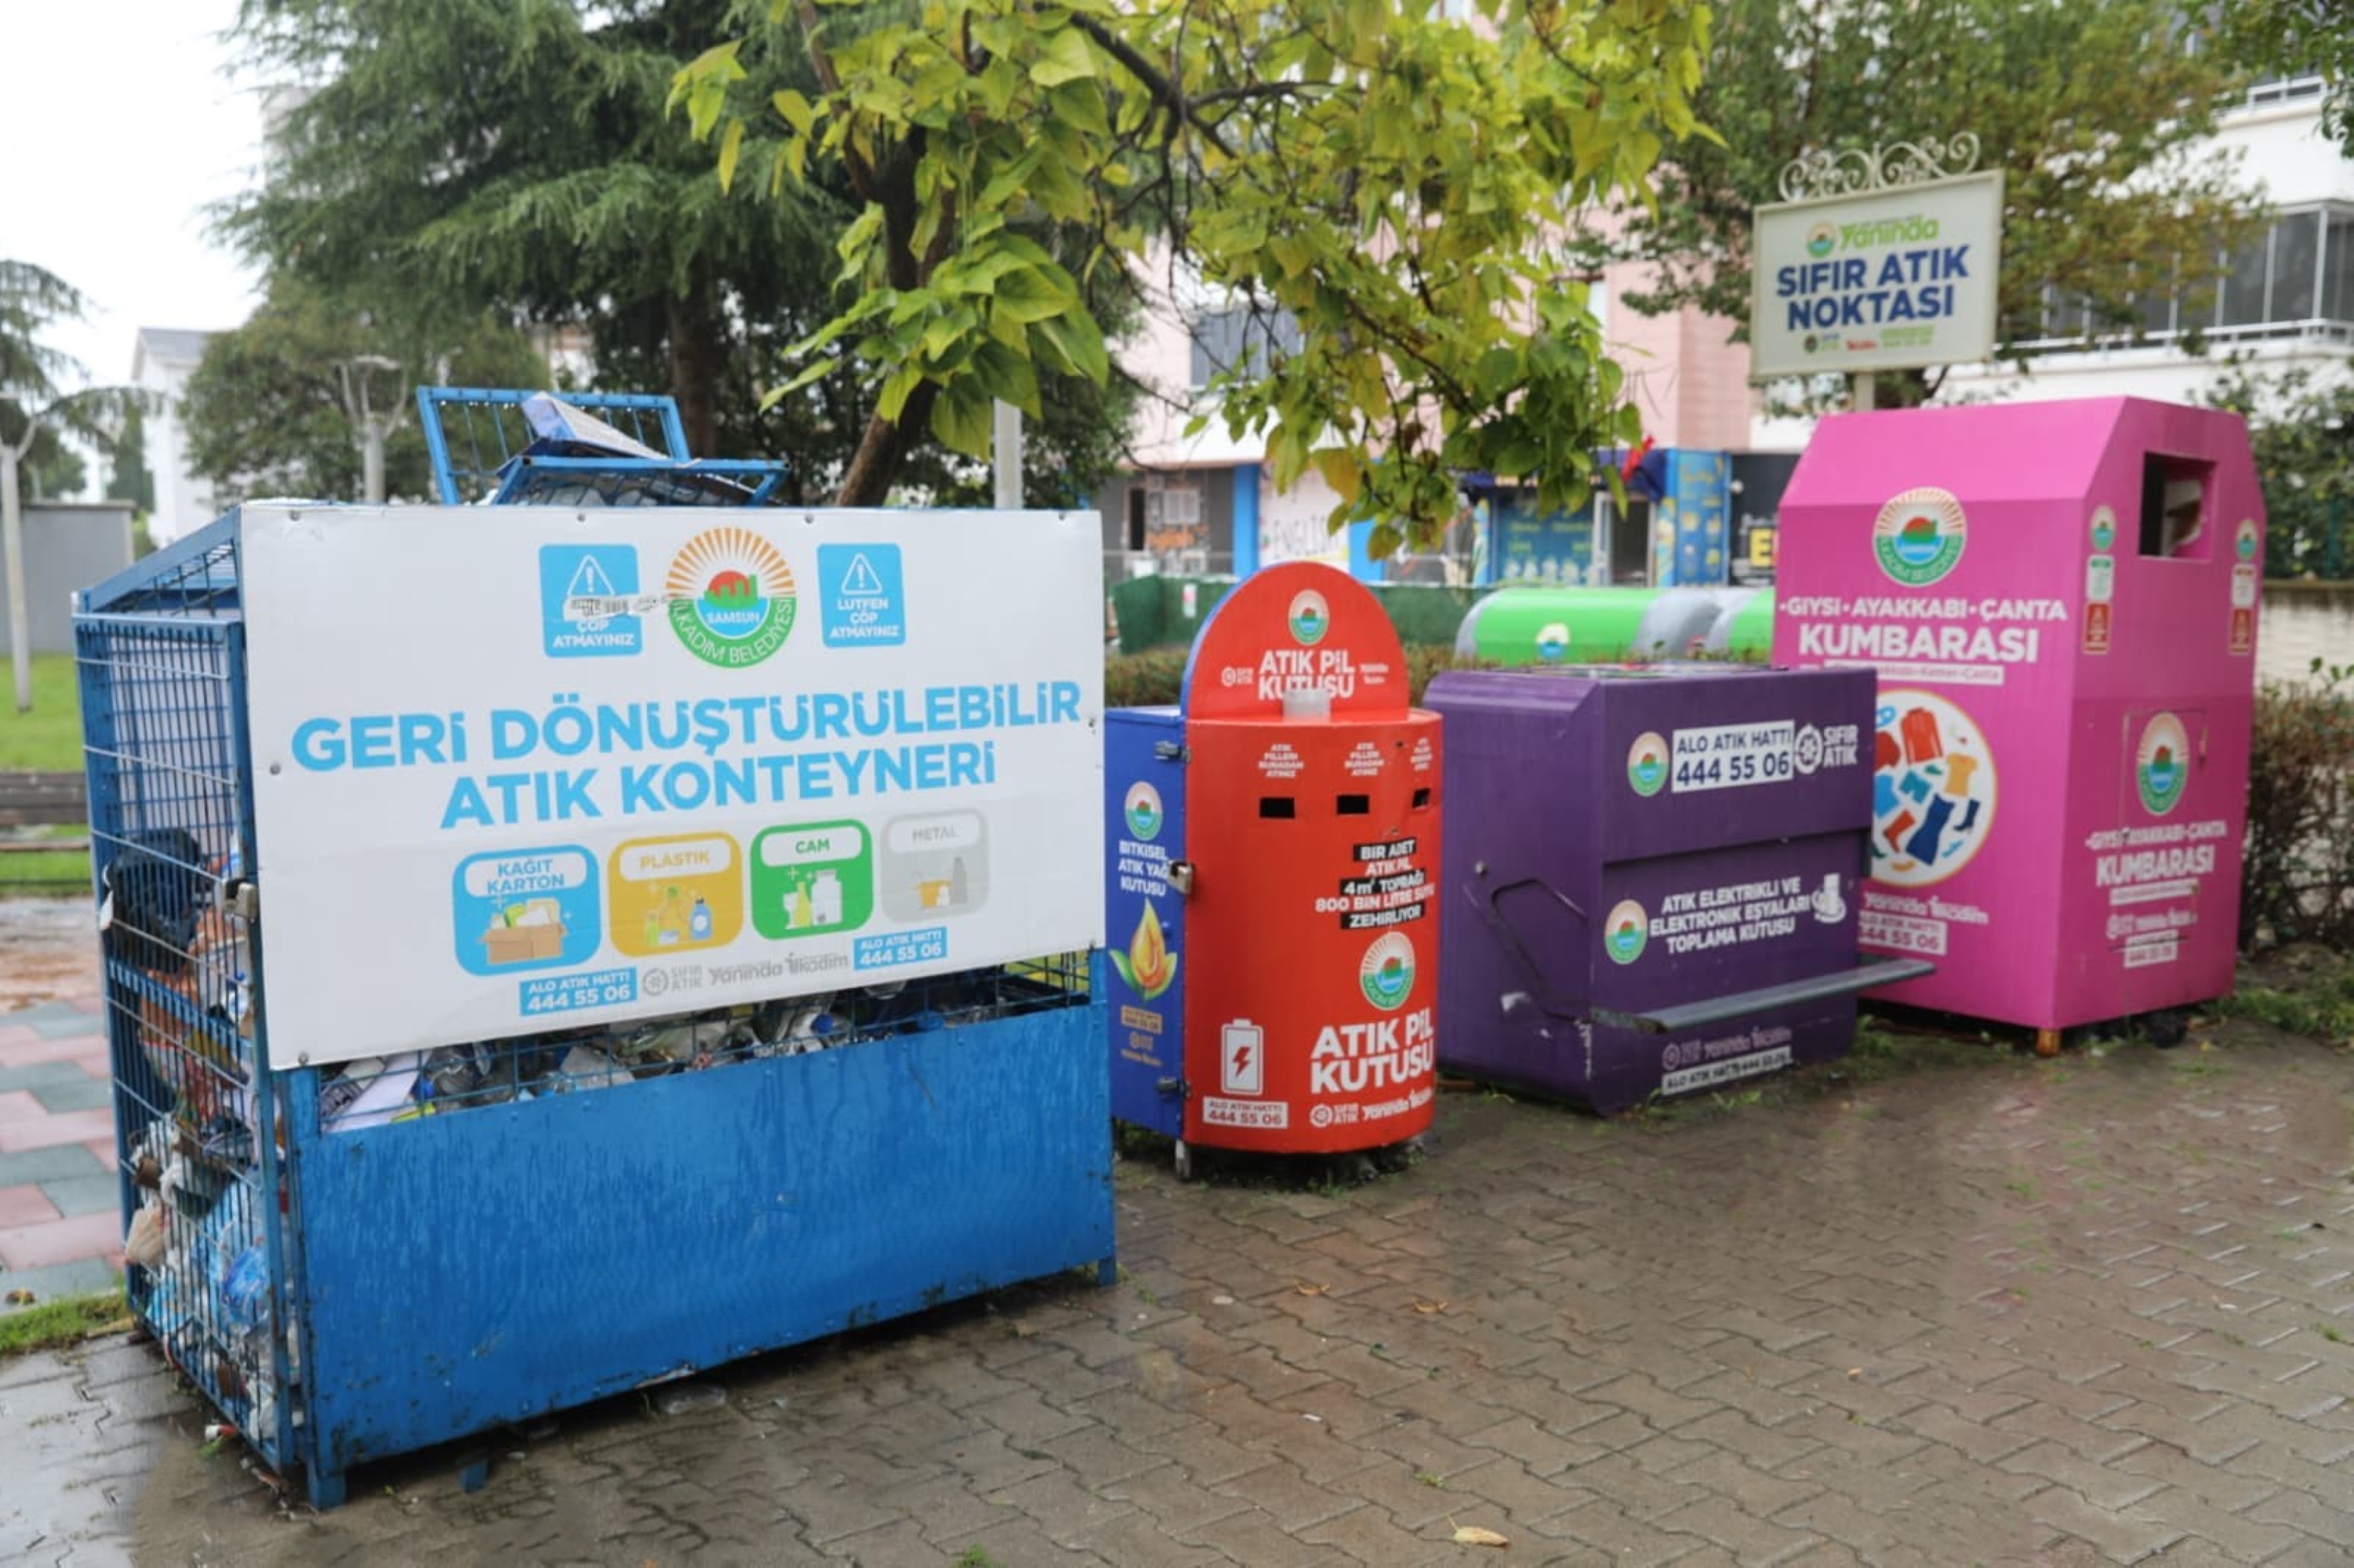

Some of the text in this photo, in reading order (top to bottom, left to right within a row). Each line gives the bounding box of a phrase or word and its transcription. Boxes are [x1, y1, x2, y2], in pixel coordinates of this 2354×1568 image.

[1777, 245, 1971, 297] SIFIR ATIK
[1788, 285, 1954, 332] NOKTASI
[707, 611, 759, 624] SAMSUN
[1980, 599, 2069, 622] ÇANTA
[553, 633, 636, 648] ATMAYINIZ
[830, 625, 899, 637] ATMAYINIZ
[1799, 622, 2040, 663] KUMBARASI
[1259, 650, 1313, 674] ATIK
[1676, 728, 1793, 754] ALO ATIK HATTI
[1676, 751, 1790, 785] 444 55 06
[1823, 745, 1858, 768] ATIK
[439, 768, 603, 829] ATIK
[795, 838, 830, 855] CAM
[912, 827, 959, 843] METAL
[1118, 858, 1144, 875] ATIK
[2096, 844, 2215, 887] KUMBARASI
[487, 874, 565, 895] KARTON
[1121, 876, 1166, 897] KUTUSU
[1662, 893, 1696, 915] ATIK
[1782, 877, 1801, 894] VE
[1315, 897, 1350, 913] 800
[1666, 916, 1796, 954] TOPLAMA KUTUSU
[860, 941, 942, 965] 444 55 06
[528, 971, 630, 995] ALO ATIK HATTI
[527, 985, 631, 1012] 444 55 06
[1310, 1018, 1399, 1059] ATIK
[1310, 1039, 1434, 1094] KUTUSU
[1209, 1110, 1282, 1126] 444 55 06
